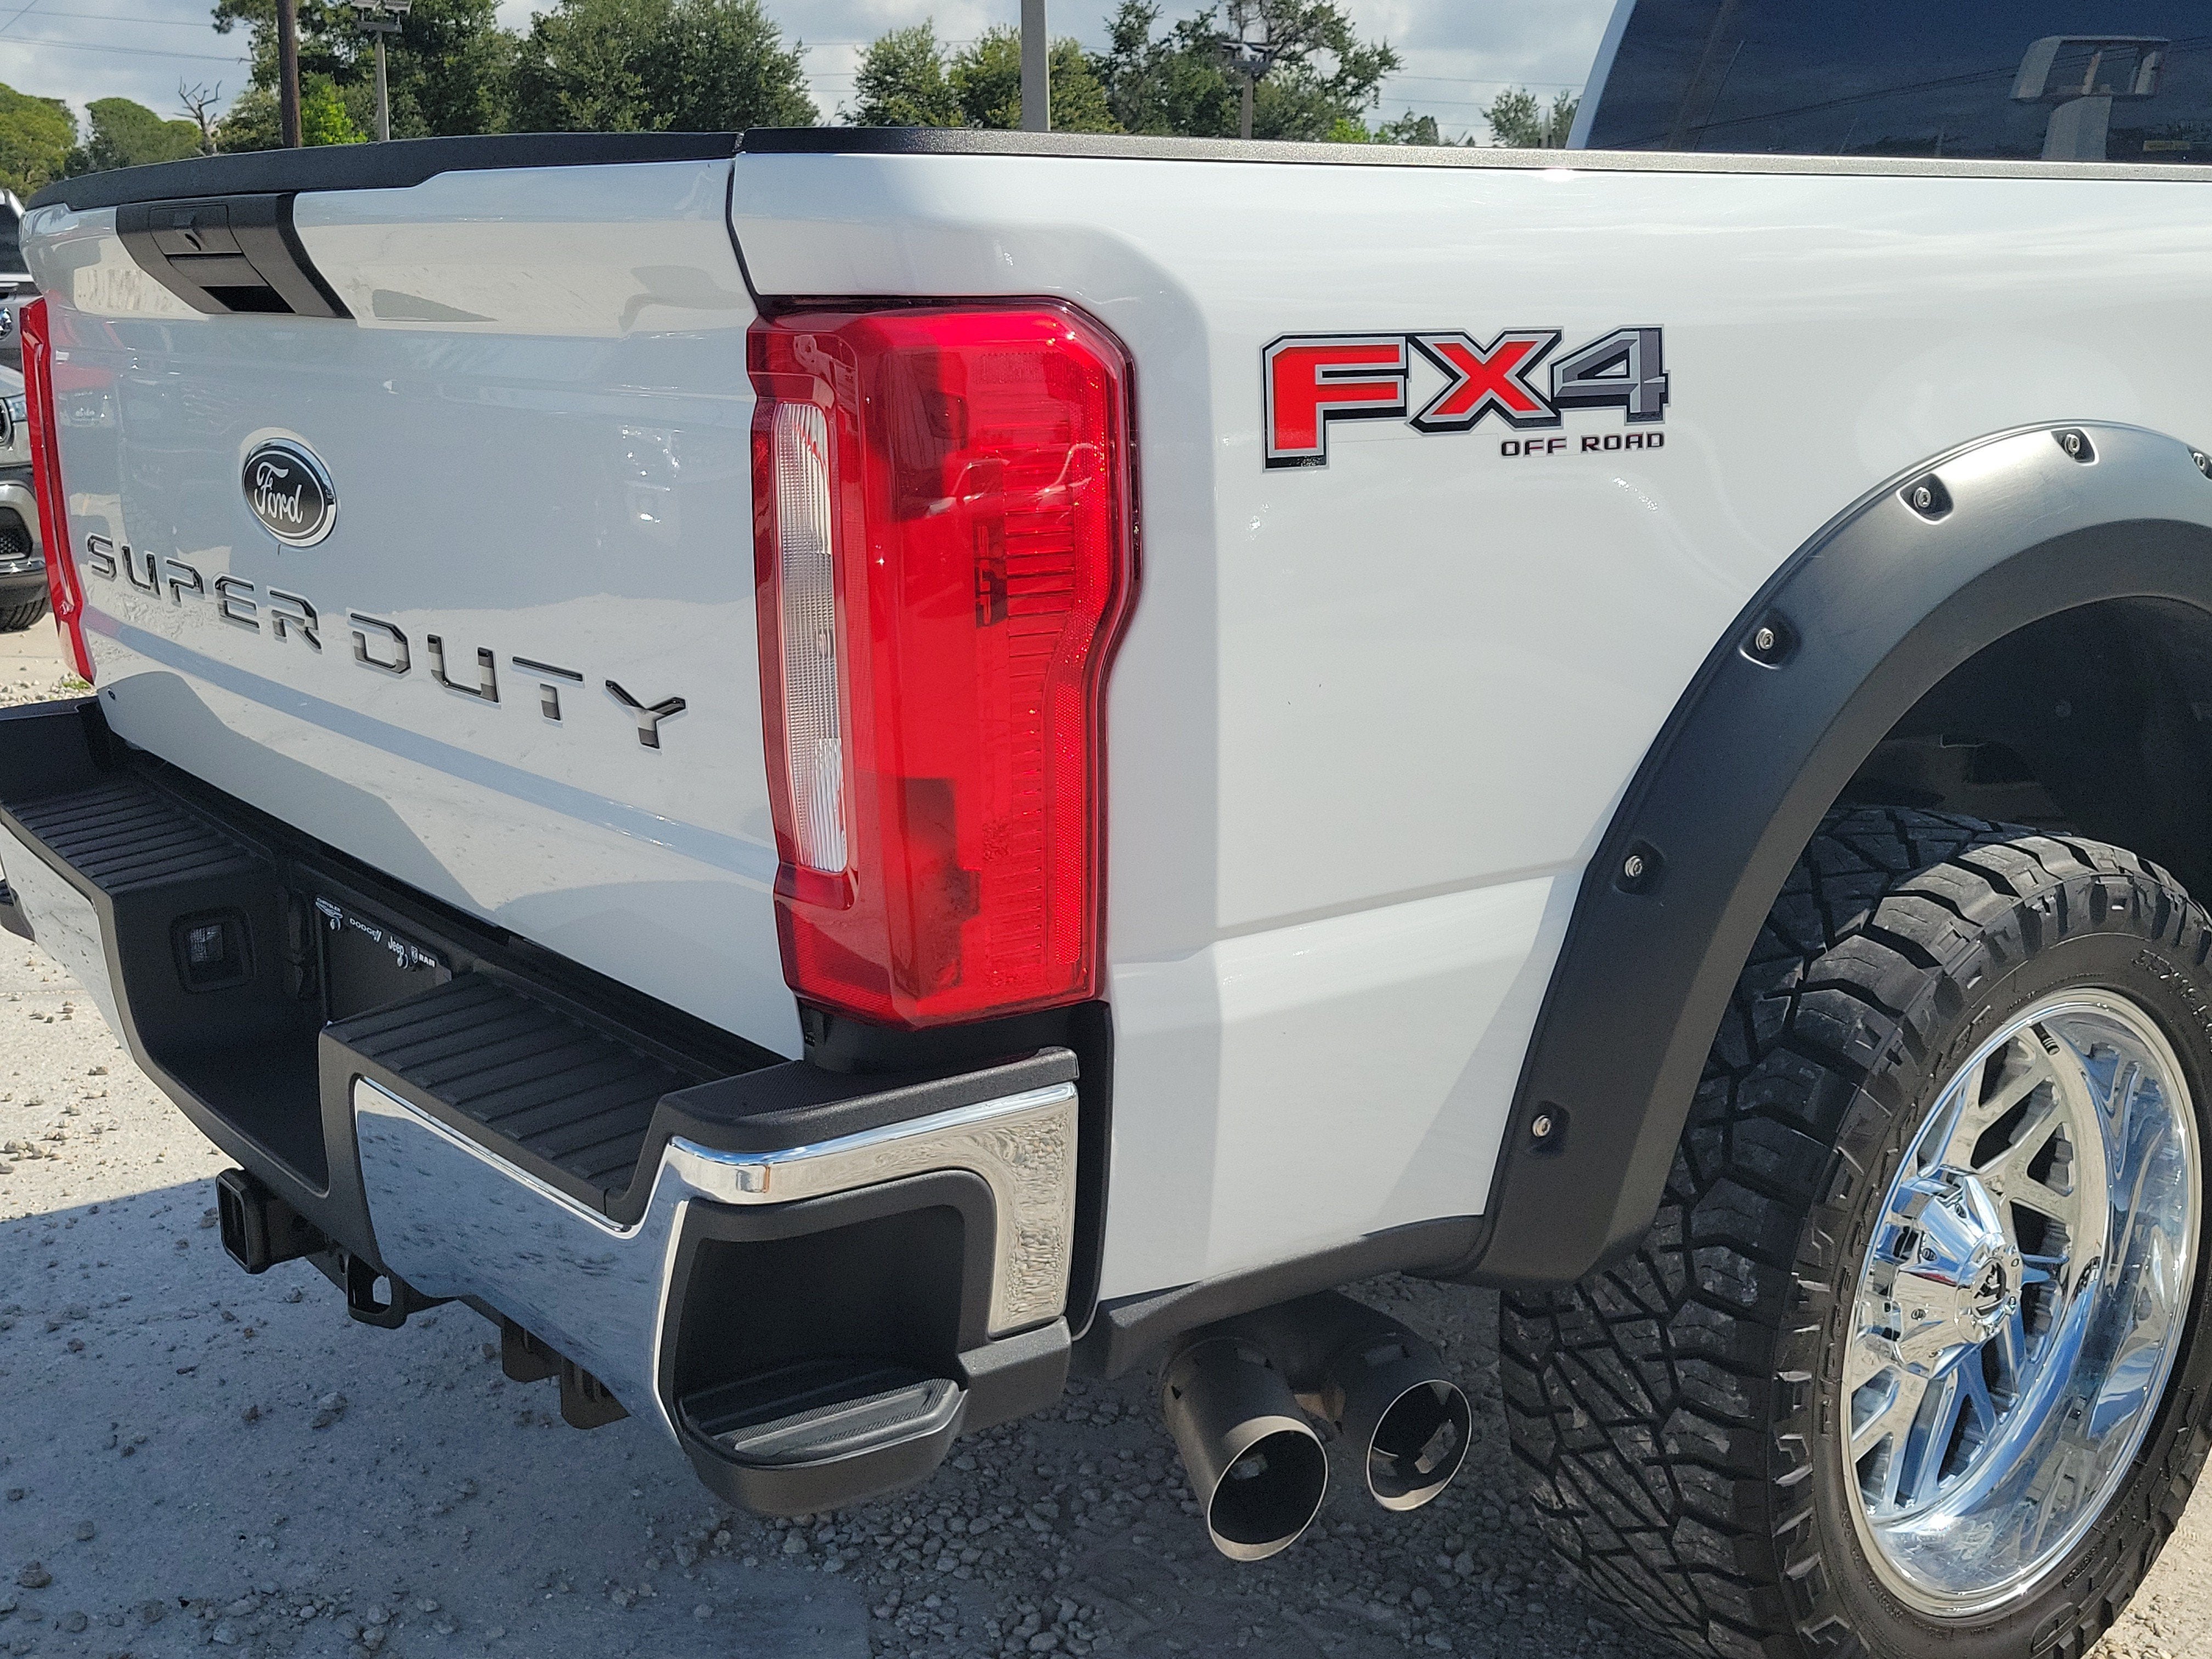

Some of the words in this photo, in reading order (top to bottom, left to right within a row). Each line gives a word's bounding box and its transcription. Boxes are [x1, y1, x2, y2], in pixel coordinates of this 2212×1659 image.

[1260, 325, 1671, 473] FX4
[1500, 437, 1567, 456] OFF
[1581, 431, 1664, 453] ROAD
[254, 461, 303, 523] Ford
[87, 532, 322, 654] SUPER
[349, 611, 687, 750] DUTY
[388, 935, 404, 956] Jeep
[419, 953, 435, 967] RAM
